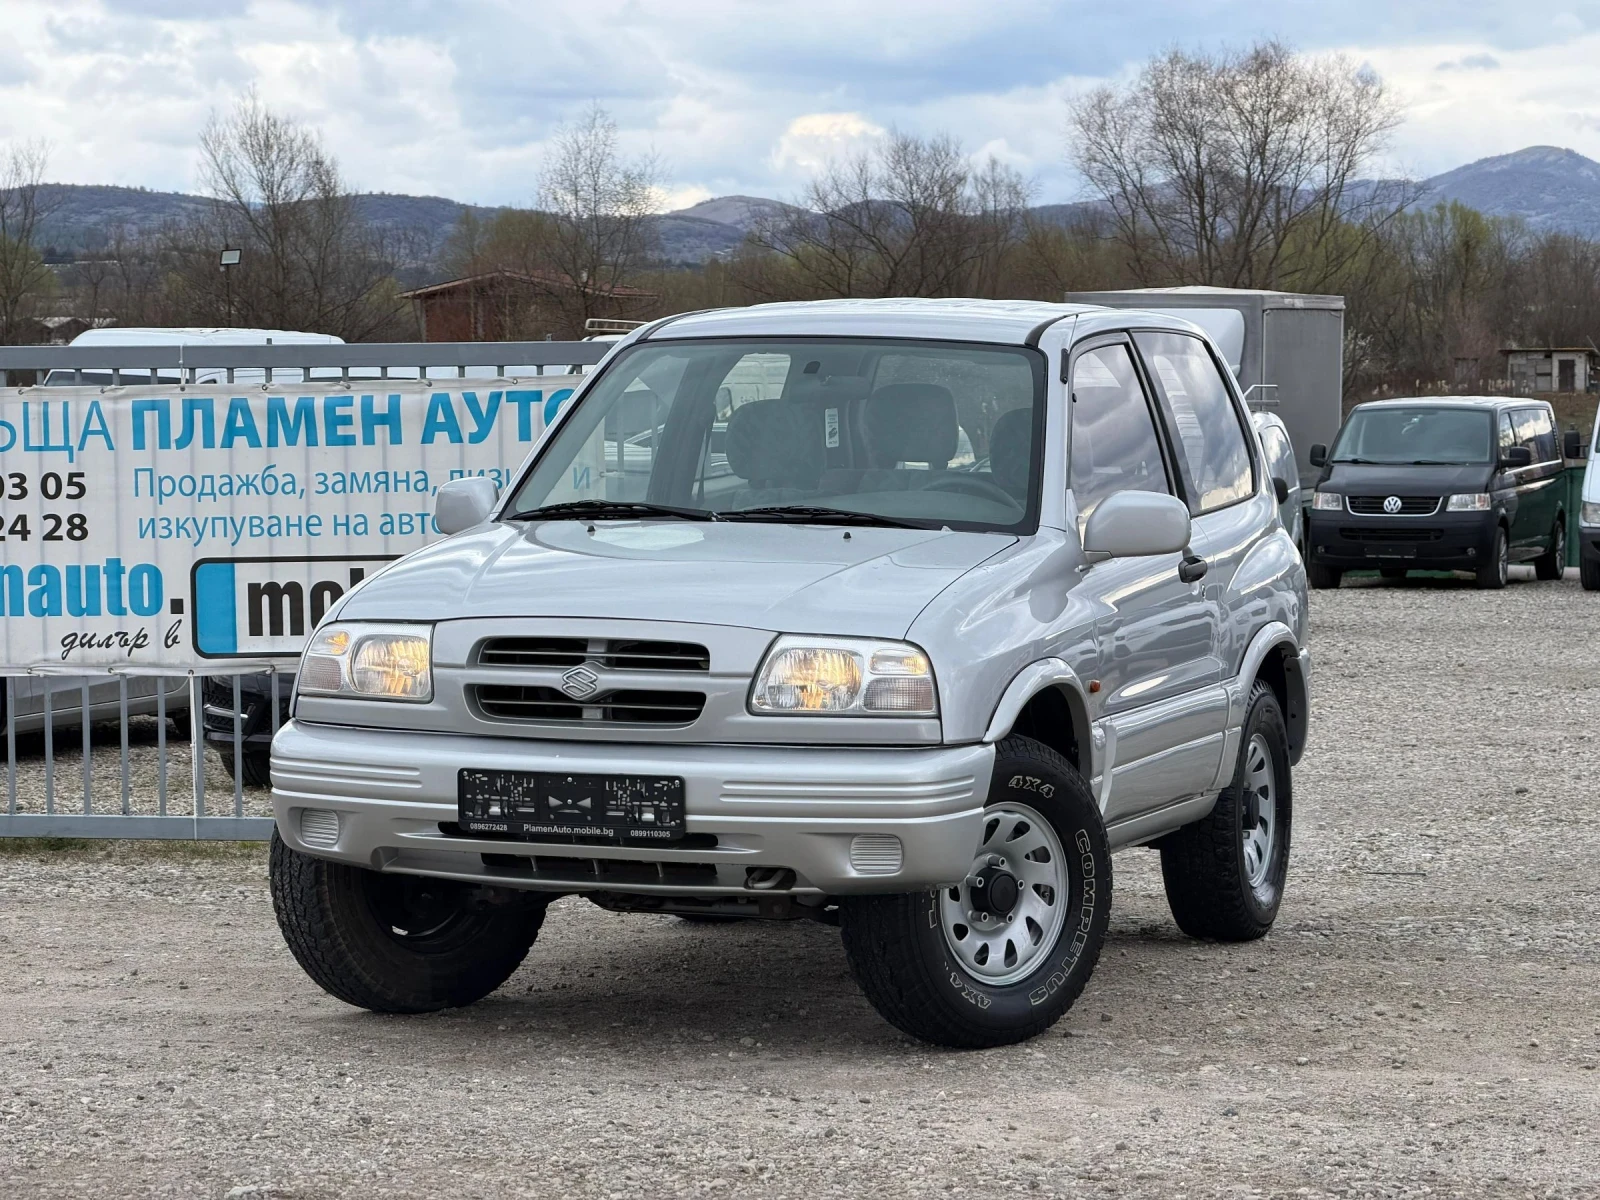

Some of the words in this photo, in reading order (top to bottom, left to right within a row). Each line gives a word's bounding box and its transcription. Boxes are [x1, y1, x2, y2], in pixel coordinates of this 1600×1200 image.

[131, 394, 403, 451] ПЛАМЕН
[0, 472, 28, 500] 3
[40, 472, 86, 500] 05
[134, 463, 306, 505] Продажба,
[314, 469, 438, 497] замяна,
[0, 514, 31, 542] 4
[42, 513, 89, 541] 28
[138, 514, 323, 547] изкупуване
[332, 513, 370, 537] на
[247, 567, 365, 637] mo
[60, 628, 150, 661] дилър
[163, 618, 182, 649] в
[523, 823, 614, 836] PlamenAuto.mobile.bg
[1028, 828, 1096, 1006] COMPETUS
